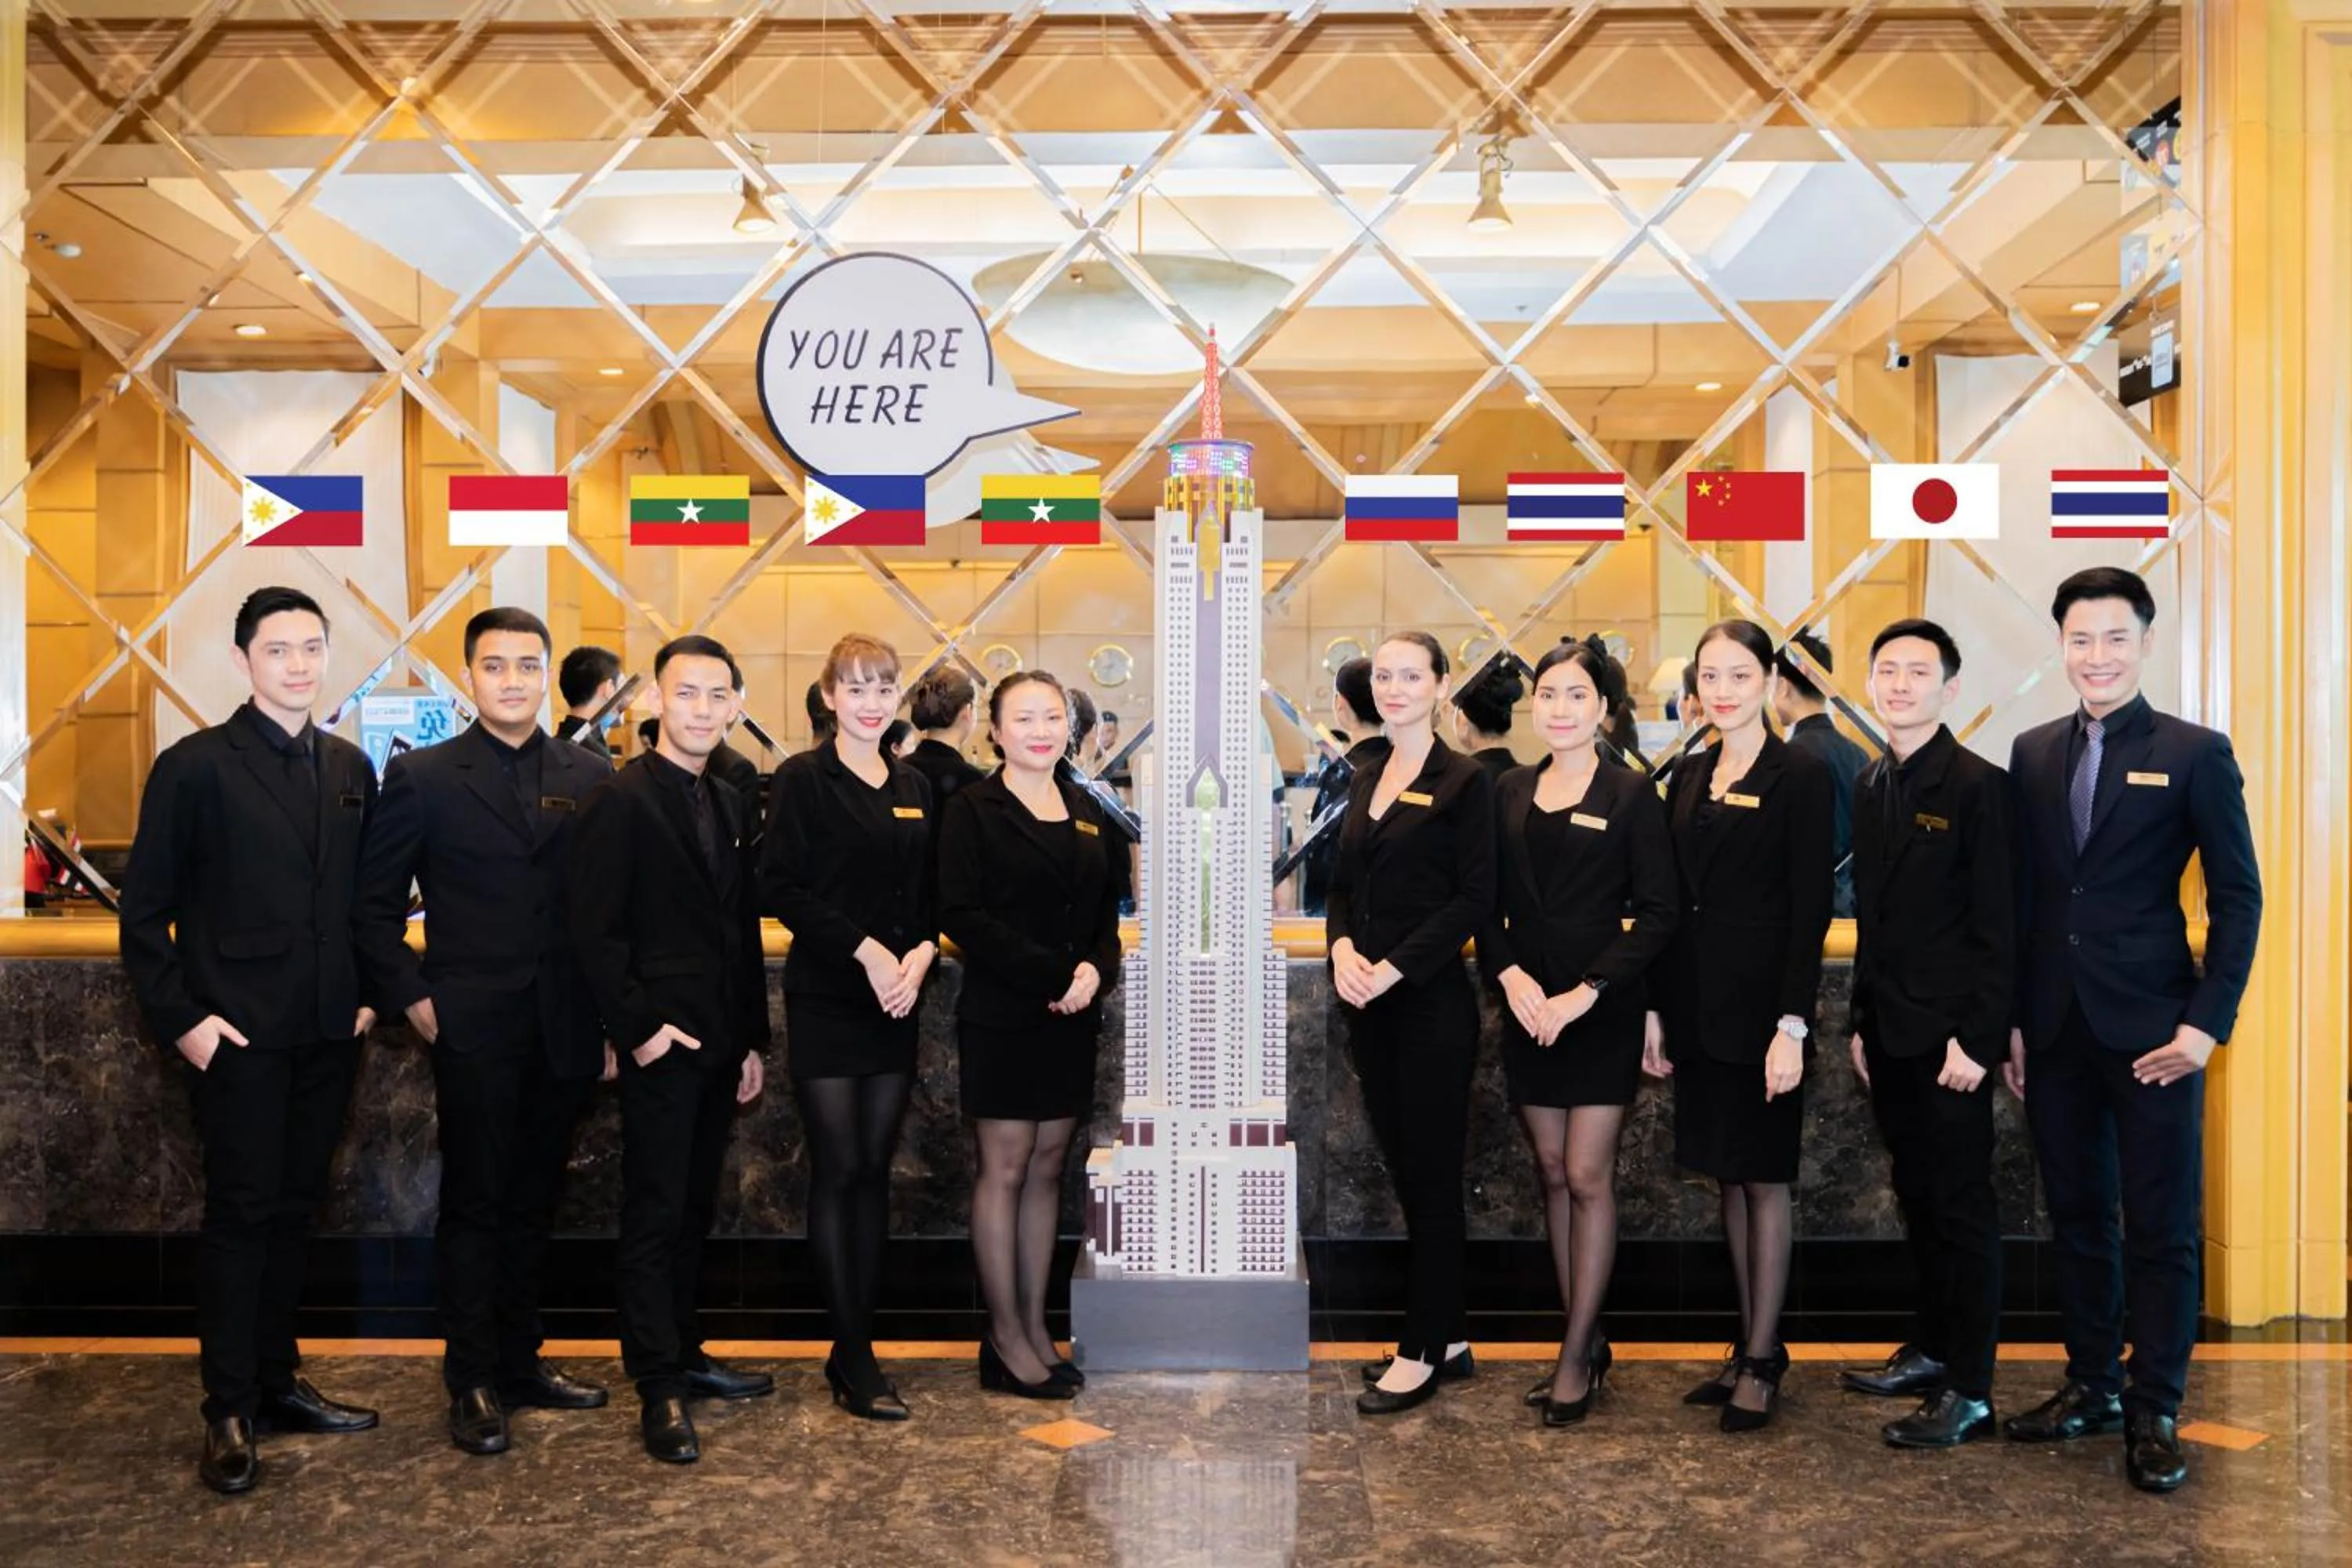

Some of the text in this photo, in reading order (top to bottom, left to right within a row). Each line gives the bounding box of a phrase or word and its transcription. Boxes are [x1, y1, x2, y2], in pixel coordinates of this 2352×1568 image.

[788, 328, 964, 371] YOU ARE
[810, 383, 928, 426] HERE
